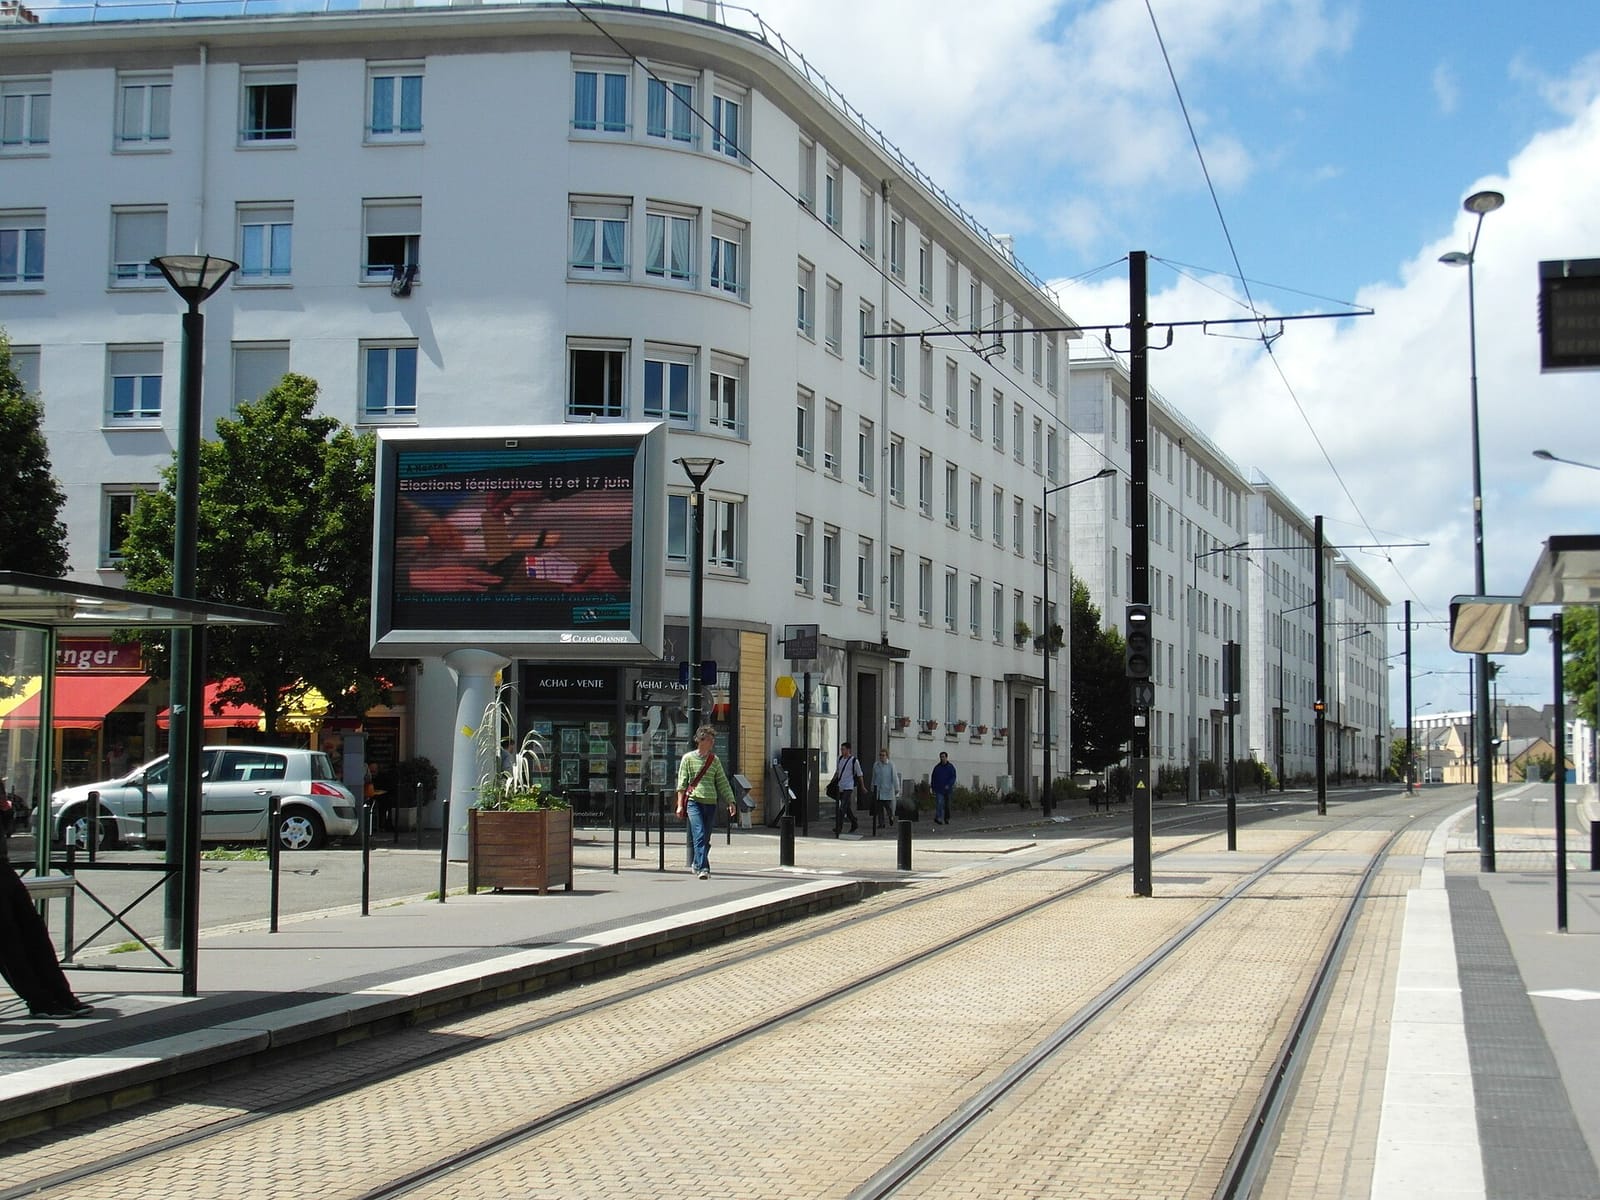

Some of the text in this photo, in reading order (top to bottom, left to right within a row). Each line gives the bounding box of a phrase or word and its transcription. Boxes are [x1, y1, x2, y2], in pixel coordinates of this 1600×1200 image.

[399, 476, 630, 493] Elections législatives 10 et 17 juin
[539, 679, 568, 688] ACHAT
[576, 679, 604, 688] VENTE
[637, 680, 662, 689] ACHAT
